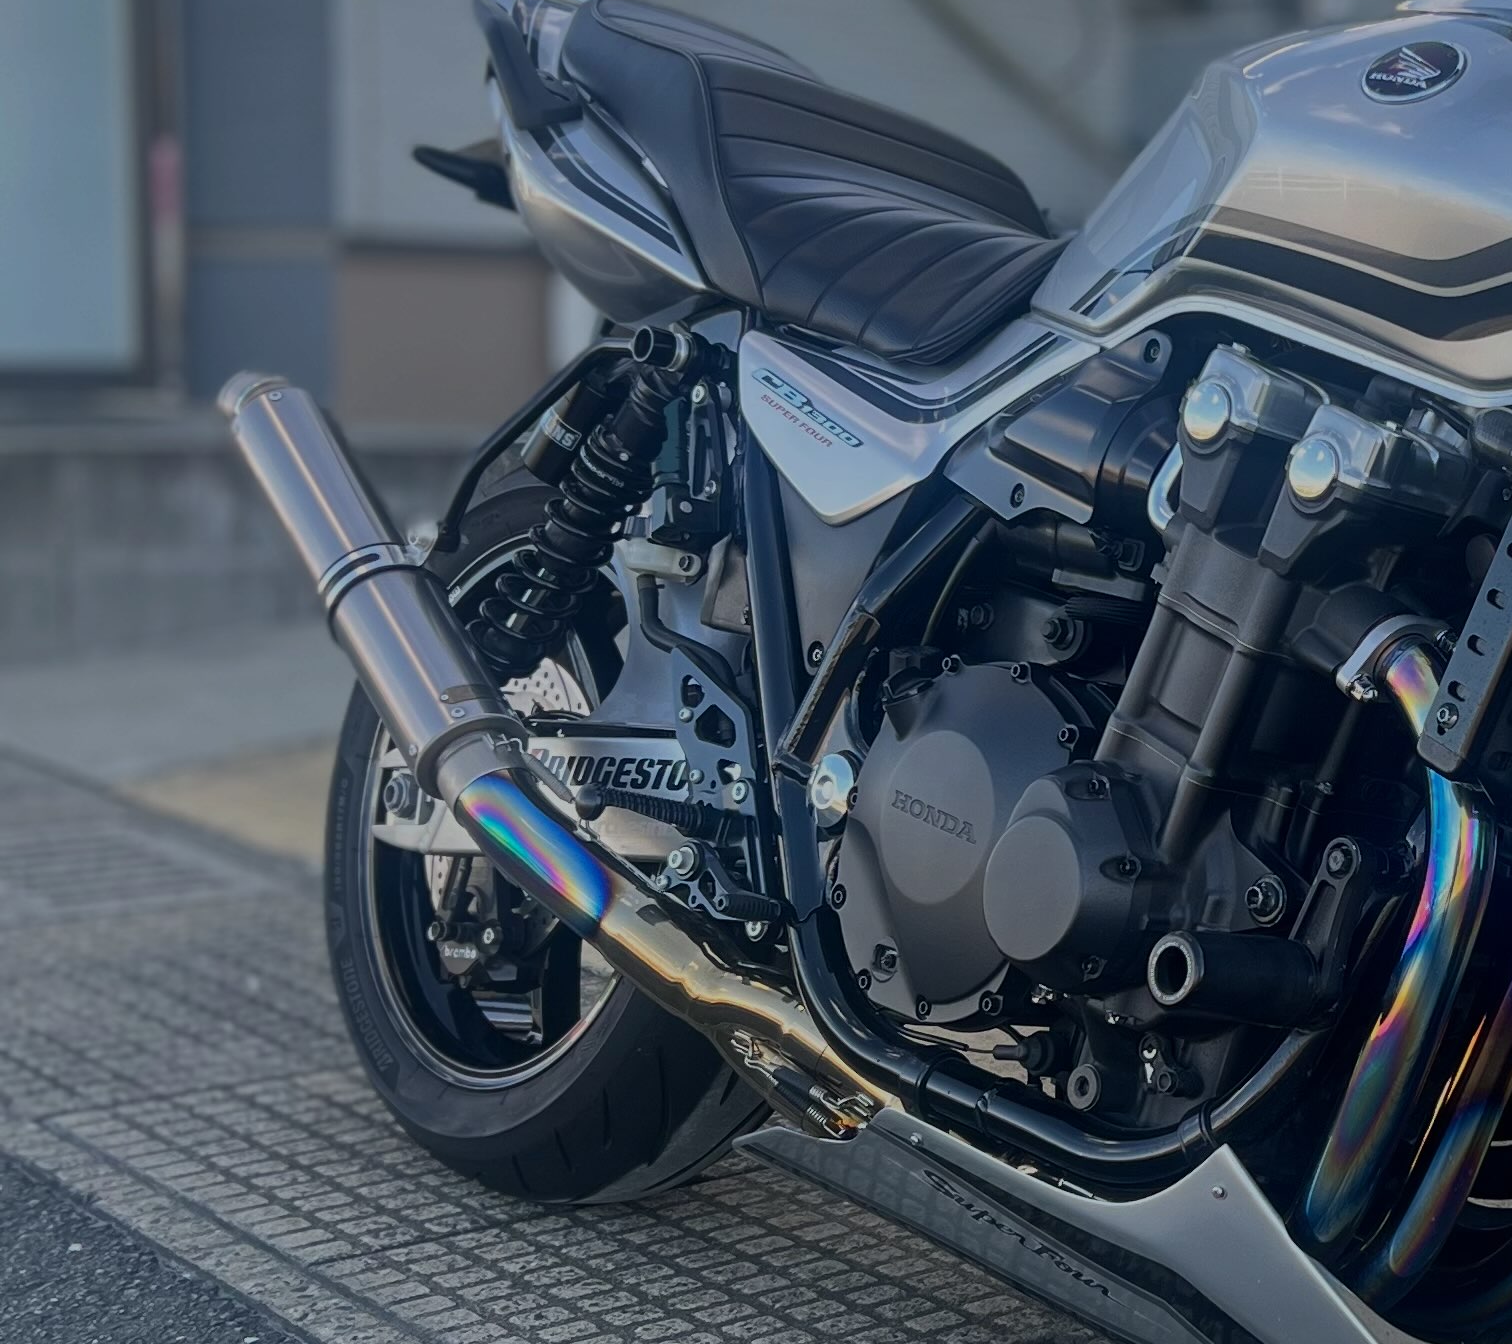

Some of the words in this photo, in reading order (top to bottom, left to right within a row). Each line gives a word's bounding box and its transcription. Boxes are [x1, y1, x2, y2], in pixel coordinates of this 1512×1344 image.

[1369, 72, 1427, 89] HONDA
[752, 367, 864, 448] CB1300
[761, 394, 800, 424] SUPER
[799, 422, 833, 448] FOUR
[891, 789, 977, 845] HONDA
[444, 944, 477, 959] brembo
[341, 956, 395, 1072] BRIDGESTONE
[923, 1169, 1034, 1248] Super
[1033, 1239, 1114, 1298] Four
